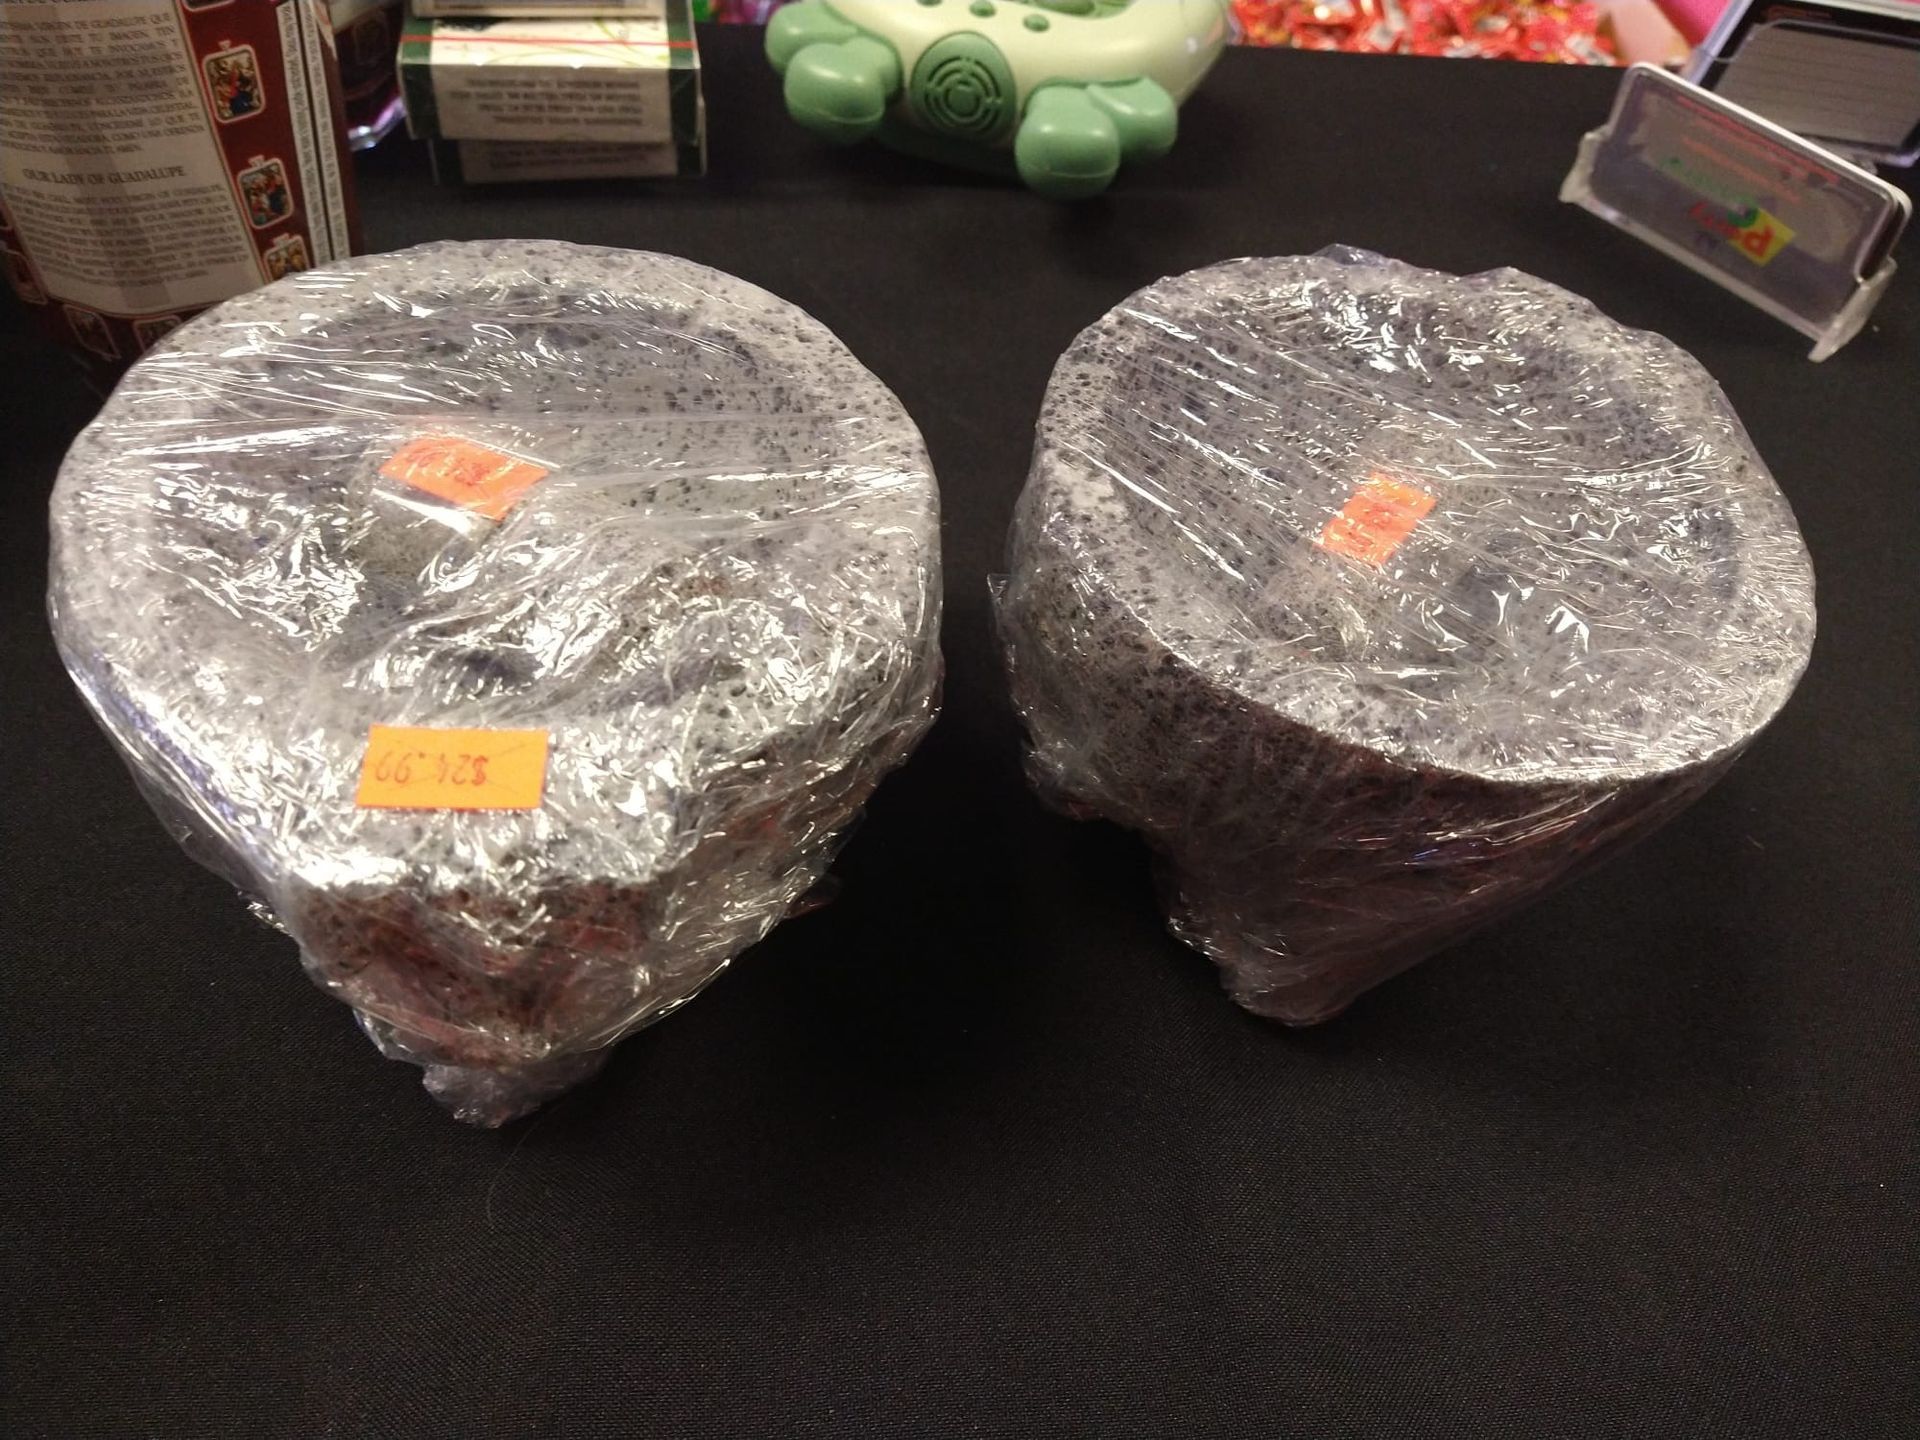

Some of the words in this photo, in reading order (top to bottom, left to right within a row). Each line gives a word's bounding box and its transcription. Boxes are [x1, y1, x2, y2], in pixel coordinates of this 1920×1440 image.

[22, 168, 50, 182] OUR
[51, 172, 84, 185] LADY
[87, 174, 106, 185] OF
[108, 165, 186, 185] GUADALUPE
